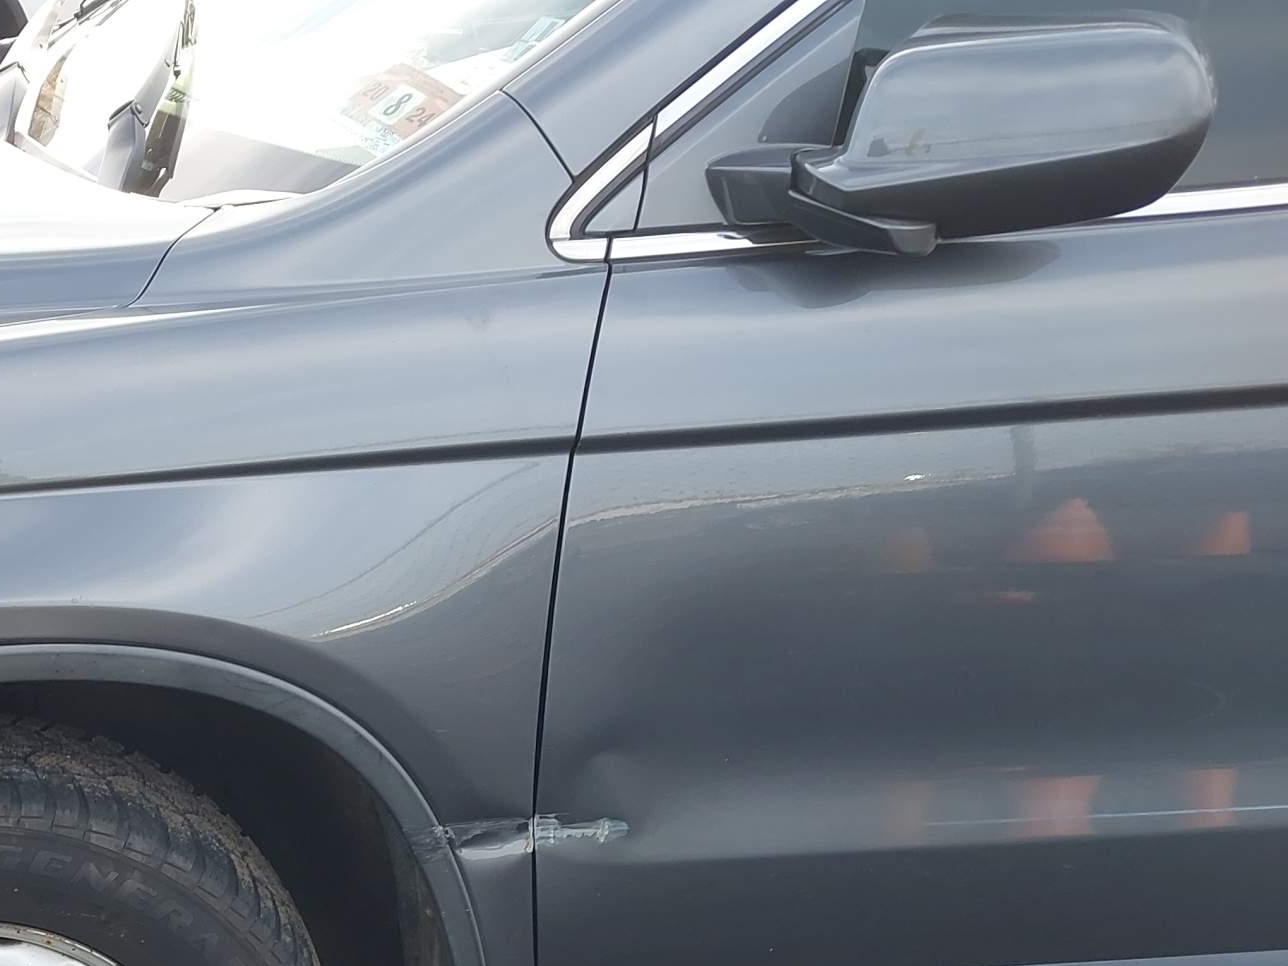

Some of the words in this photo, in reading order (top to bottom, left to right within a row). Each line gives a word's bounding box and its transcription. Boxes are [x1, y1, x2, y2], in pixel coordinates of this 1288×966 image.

[361, 81, 390, 101] 20
[382, 92, 414, 117] 8
[405, 106, 440, 128] 24
